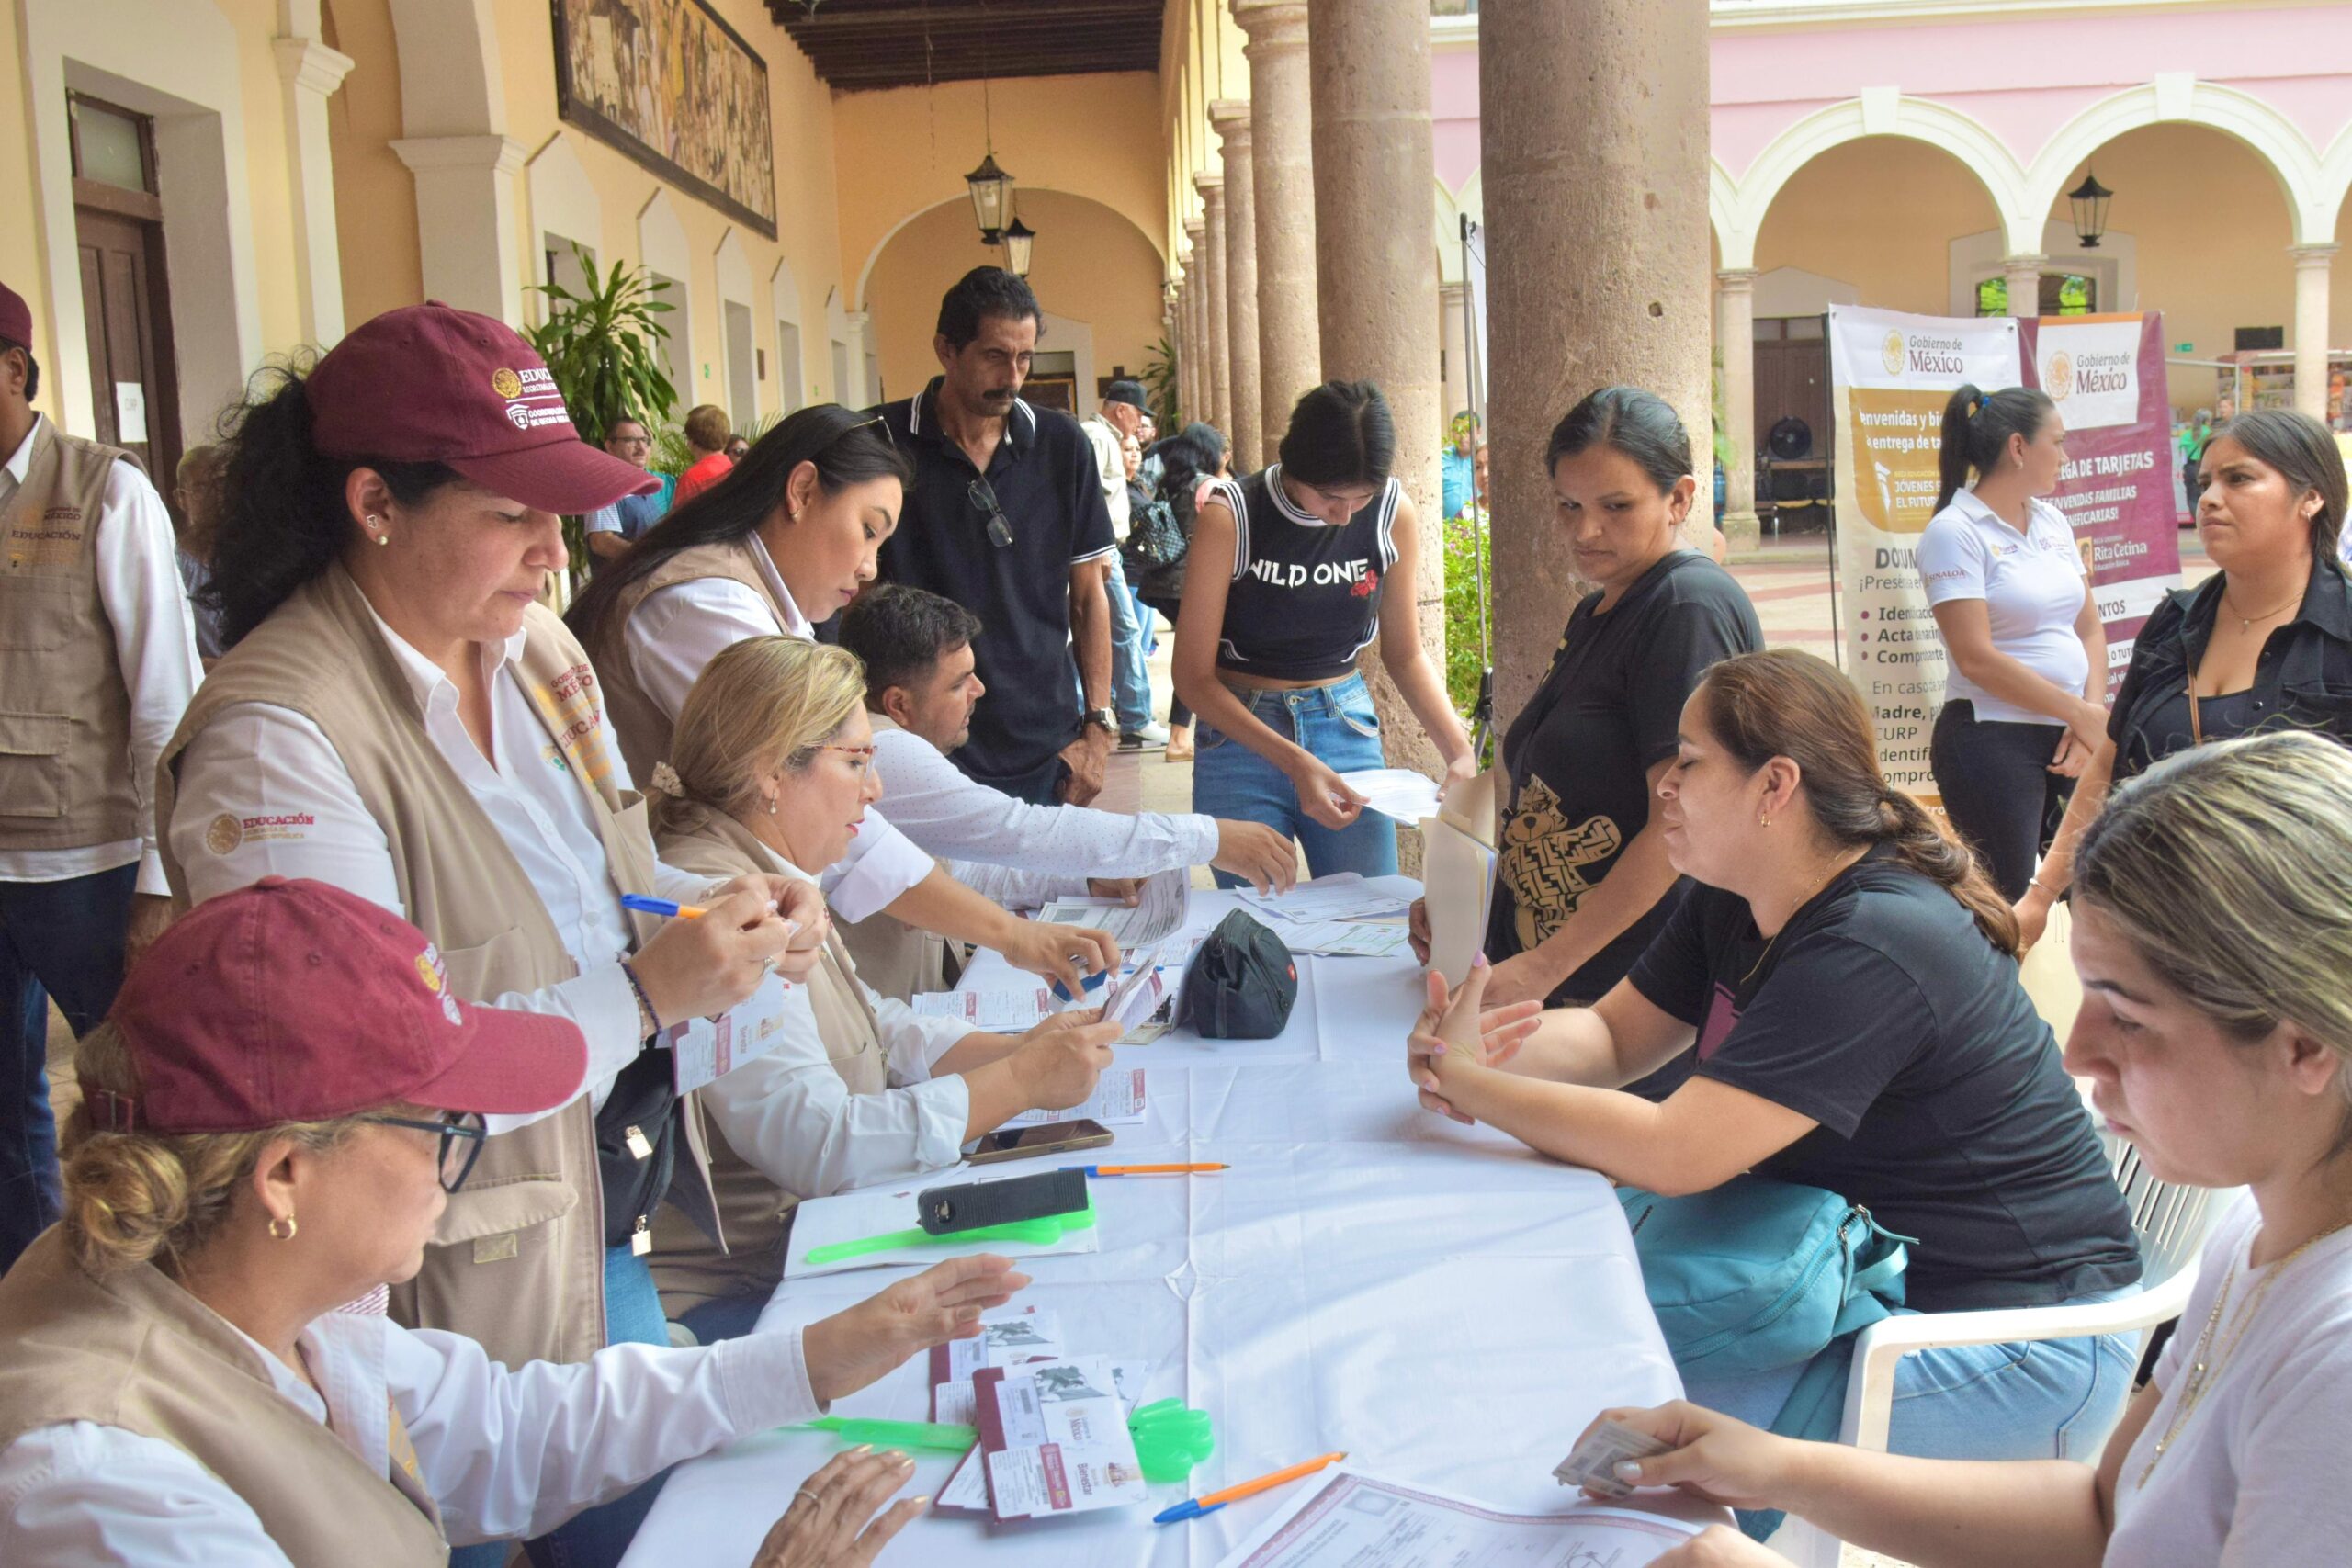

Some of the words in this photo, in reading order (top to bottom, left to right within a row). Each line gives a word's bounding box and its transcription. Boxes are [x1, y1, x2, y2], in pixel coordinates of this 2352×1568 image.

[1909, 335, 1951, 350] Gobierno
[1951, 338, 1962, 351] de
[1909, 350, 1963, 373] México
[2076, 354, 2119, 367] Gobierno
[2120, 351, 2131, 365] de
[2076, 367, 2127, 394] México
[1859, 408, 1917, 427] envenidas
[1919, 414, 1927, 431] y
[1928, 410, 1943, 427] bi
[1872, 436, 1915, 454] entrega
[1916, 434, 1929, 449] de
[1931, 435, 1942, 450] ta
[2079, 458, 2093, 477] DE
[2093, 451, 2154, 478] TARJETAS
[1894, 479, 1934, 493] JÓVENES
[2094, 485, 2137, 503] FAMILIAS
[1895, 497, 1907, 508] EL
[1908, 496, 1939, 508] FUTUR
[2065, 507, 2120, 527] NEFICARIAS!
[11, 530, 82, 541] EDUCACIÓN
[2094, 546, 2113, 561] Rita
[2113, 540, 2148, 558] Cetina
[1313, 558, 1369, 585] ONE
[1929, 570, 1965, 581] SINALOA
[1877, 627, 1914, 642] Acta
[2118, 647, 2132, 659] TUT
[1872, 681, 1892, 694] En
[1898, 681, 1928, 694] caso
[1883, 770, 1935, 786] ompro
[243, 812, 315, 829] EDUCACIÓN
[1077, 1463, 1092, 1495] Bienestar
